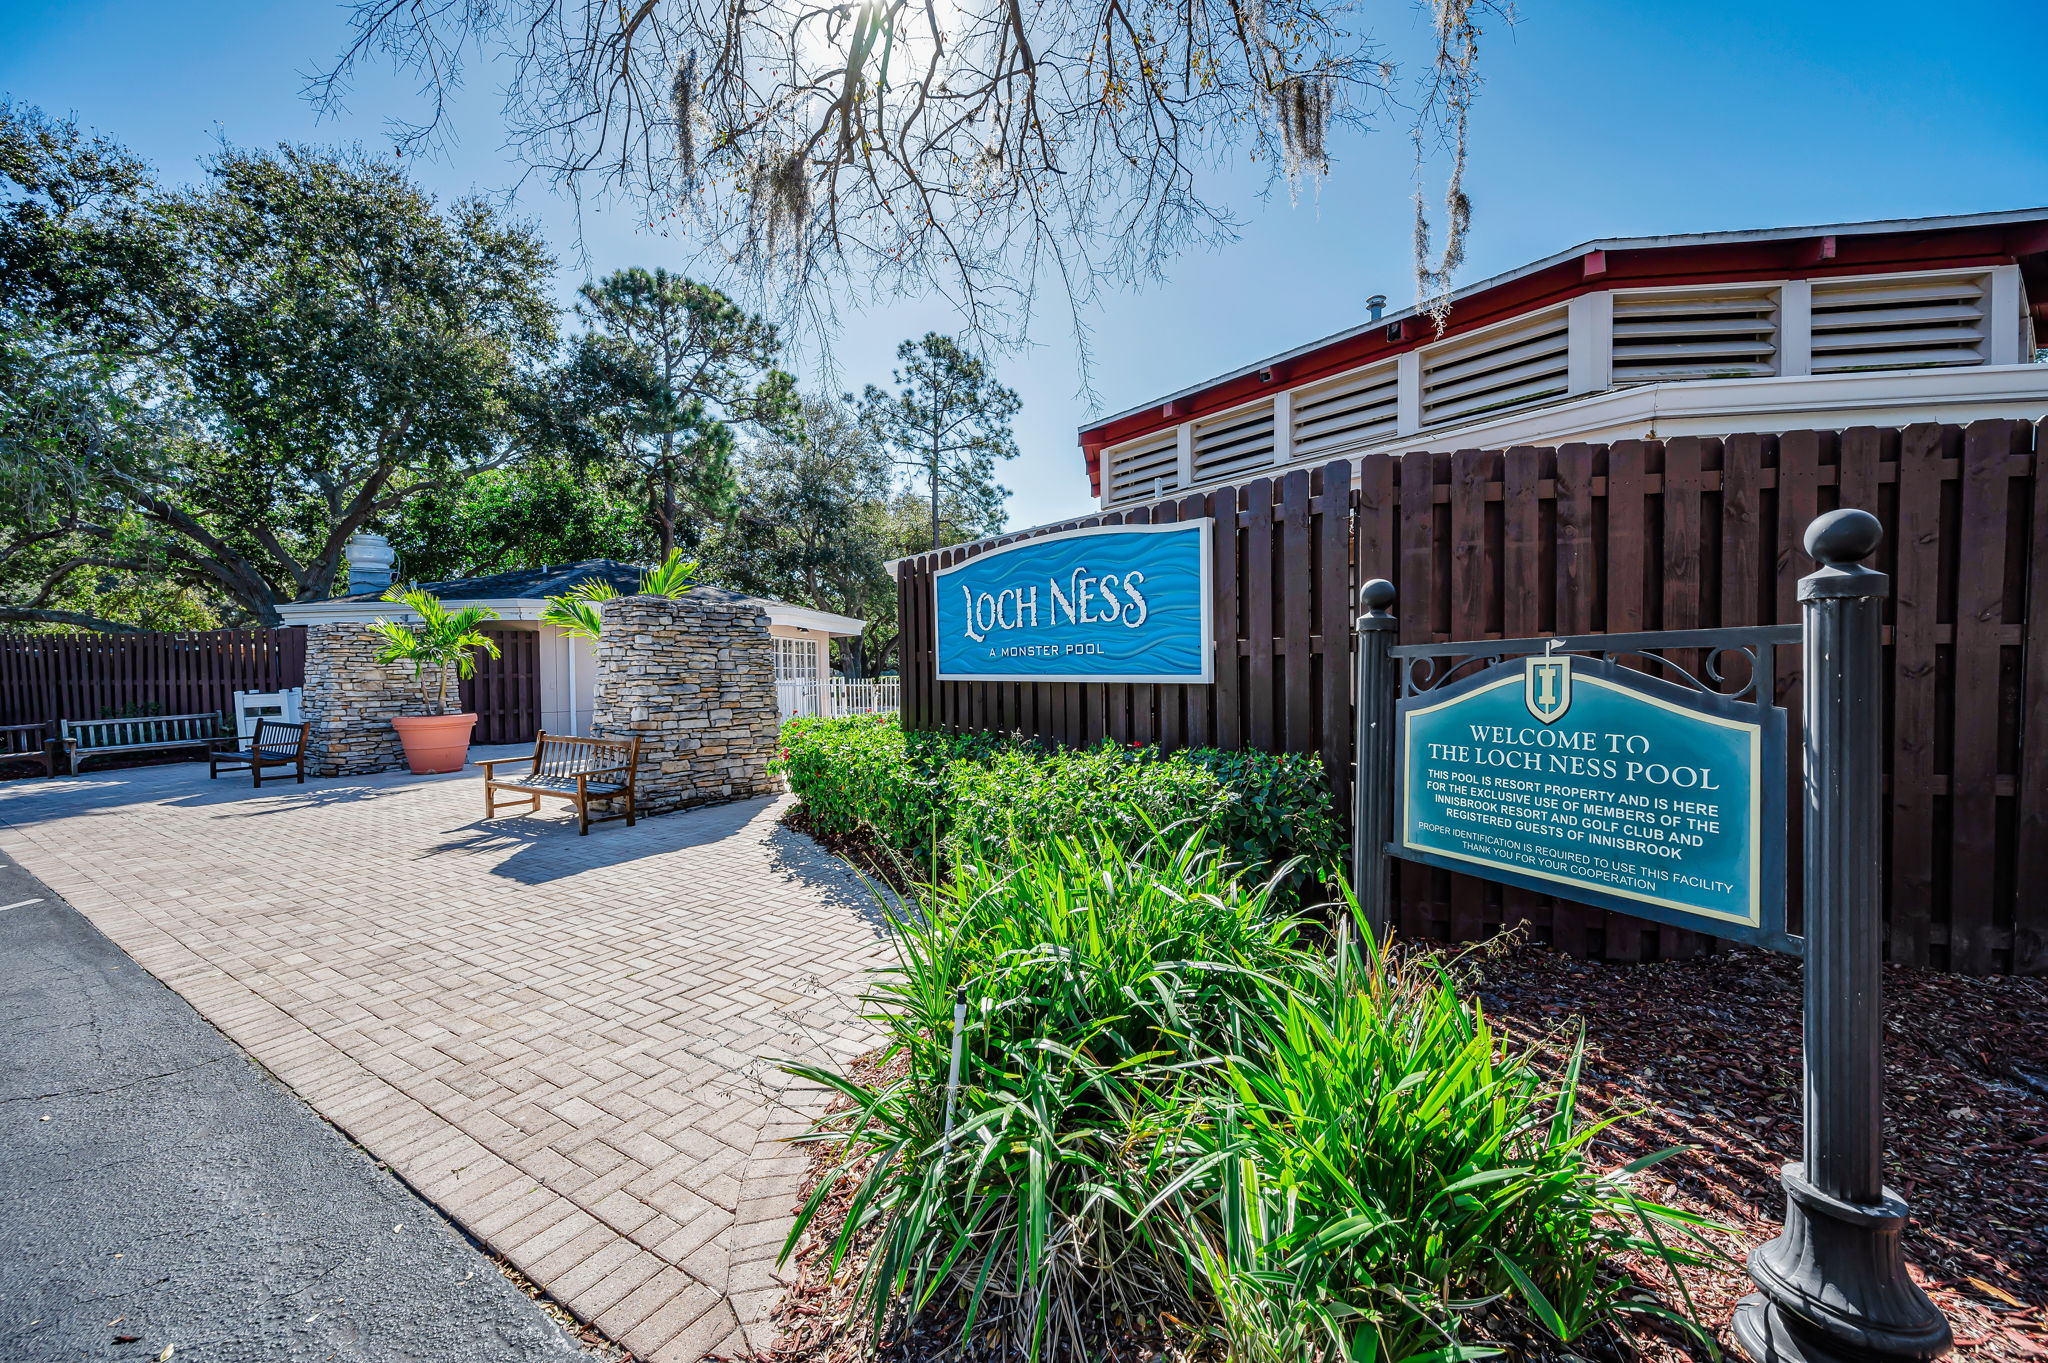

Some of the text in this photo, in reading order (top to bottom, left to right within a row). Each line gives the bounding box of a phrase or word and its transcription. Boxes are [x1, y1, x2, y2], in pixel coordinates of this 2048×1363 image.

[963, 567, 1148, 642] LOCH NESS
[989, 644, 1104, 657] A MONSTER POOL
[1469, 725, 1650, 754] WELCOME TO
[1428, 743, 1720, 791] THE LOCH NESS POOL
[1427, 781, 1719, 834] FOR THE EXCLUSIVE USE OF MEMBERS OF THE
[1428, 769, 1719, 817] THIS POOL IS RESORT PROPERTY AND IS HERE
[1435, 794, 1703, 847] INNISBROOK RESORT AND GOLF CLUB AND
[1446, 808, 1682, 860] REGISTERED GUESTS OF INNISBROOK
[1418, 821, 1733, 894] PROPER IDENTIFICATION IS REQUIRED TO USE THIS FACILITY
[1462, 841, 1656, 891] THANK YOU FOR YOUR COOPERATION
